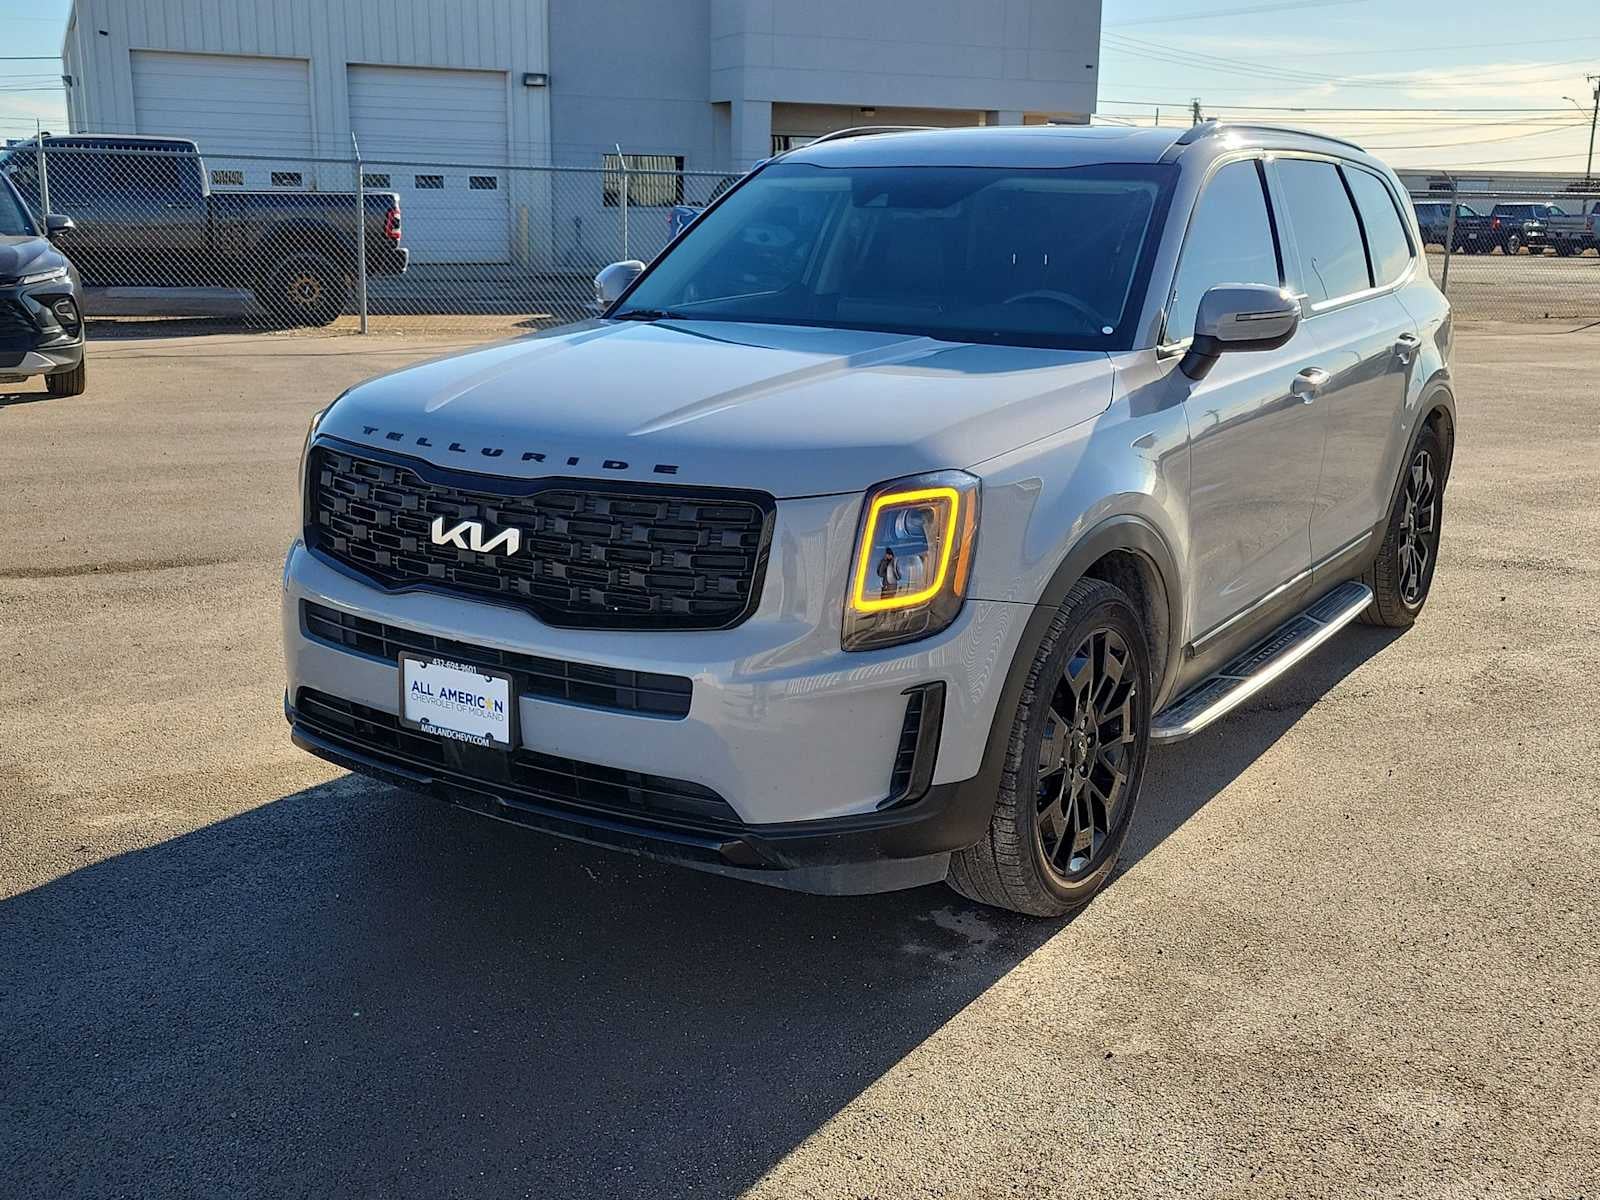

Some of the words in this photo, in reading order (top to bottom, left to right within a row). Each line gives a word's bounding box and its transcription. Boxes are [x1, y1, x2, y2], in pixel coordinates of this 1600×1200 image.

[362, 425, 679, 475] TELLURIDE
[431, 516, 520, 556] KIA
[411, 680, 434, 696] ALL
[410, 692, 455, 711] CHEVROLET
[456, 704, 467, 713] OF
[468, 707, 504, 722] MIDLAND
[420, 723, 490, 748] MIDLANDCHEVY.COM
